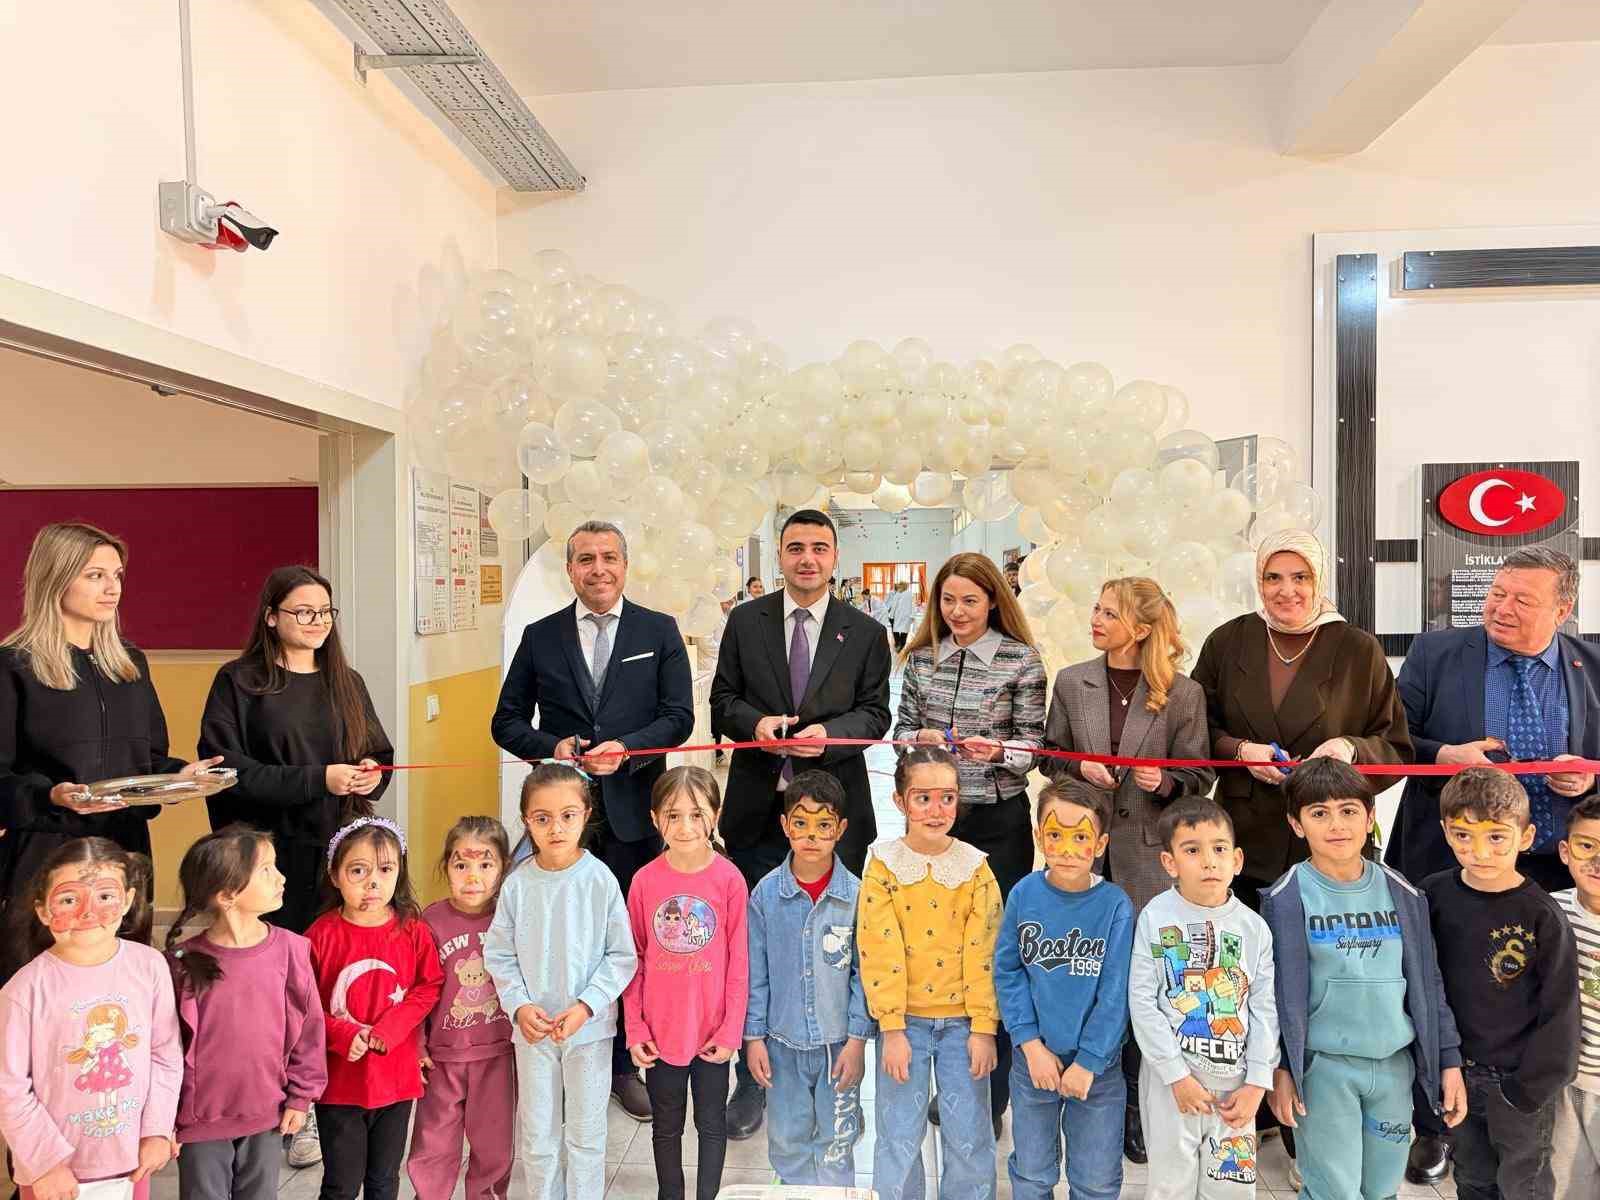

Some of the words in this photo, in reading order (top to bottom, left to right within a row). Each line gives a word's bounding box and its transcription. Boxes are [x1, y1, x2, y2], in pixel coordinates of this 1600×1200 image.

[440, 933, 470, 966] NEW
[1017, 921, 1106, 966] Boston
[1068, 959, 1102, 976] 1999
